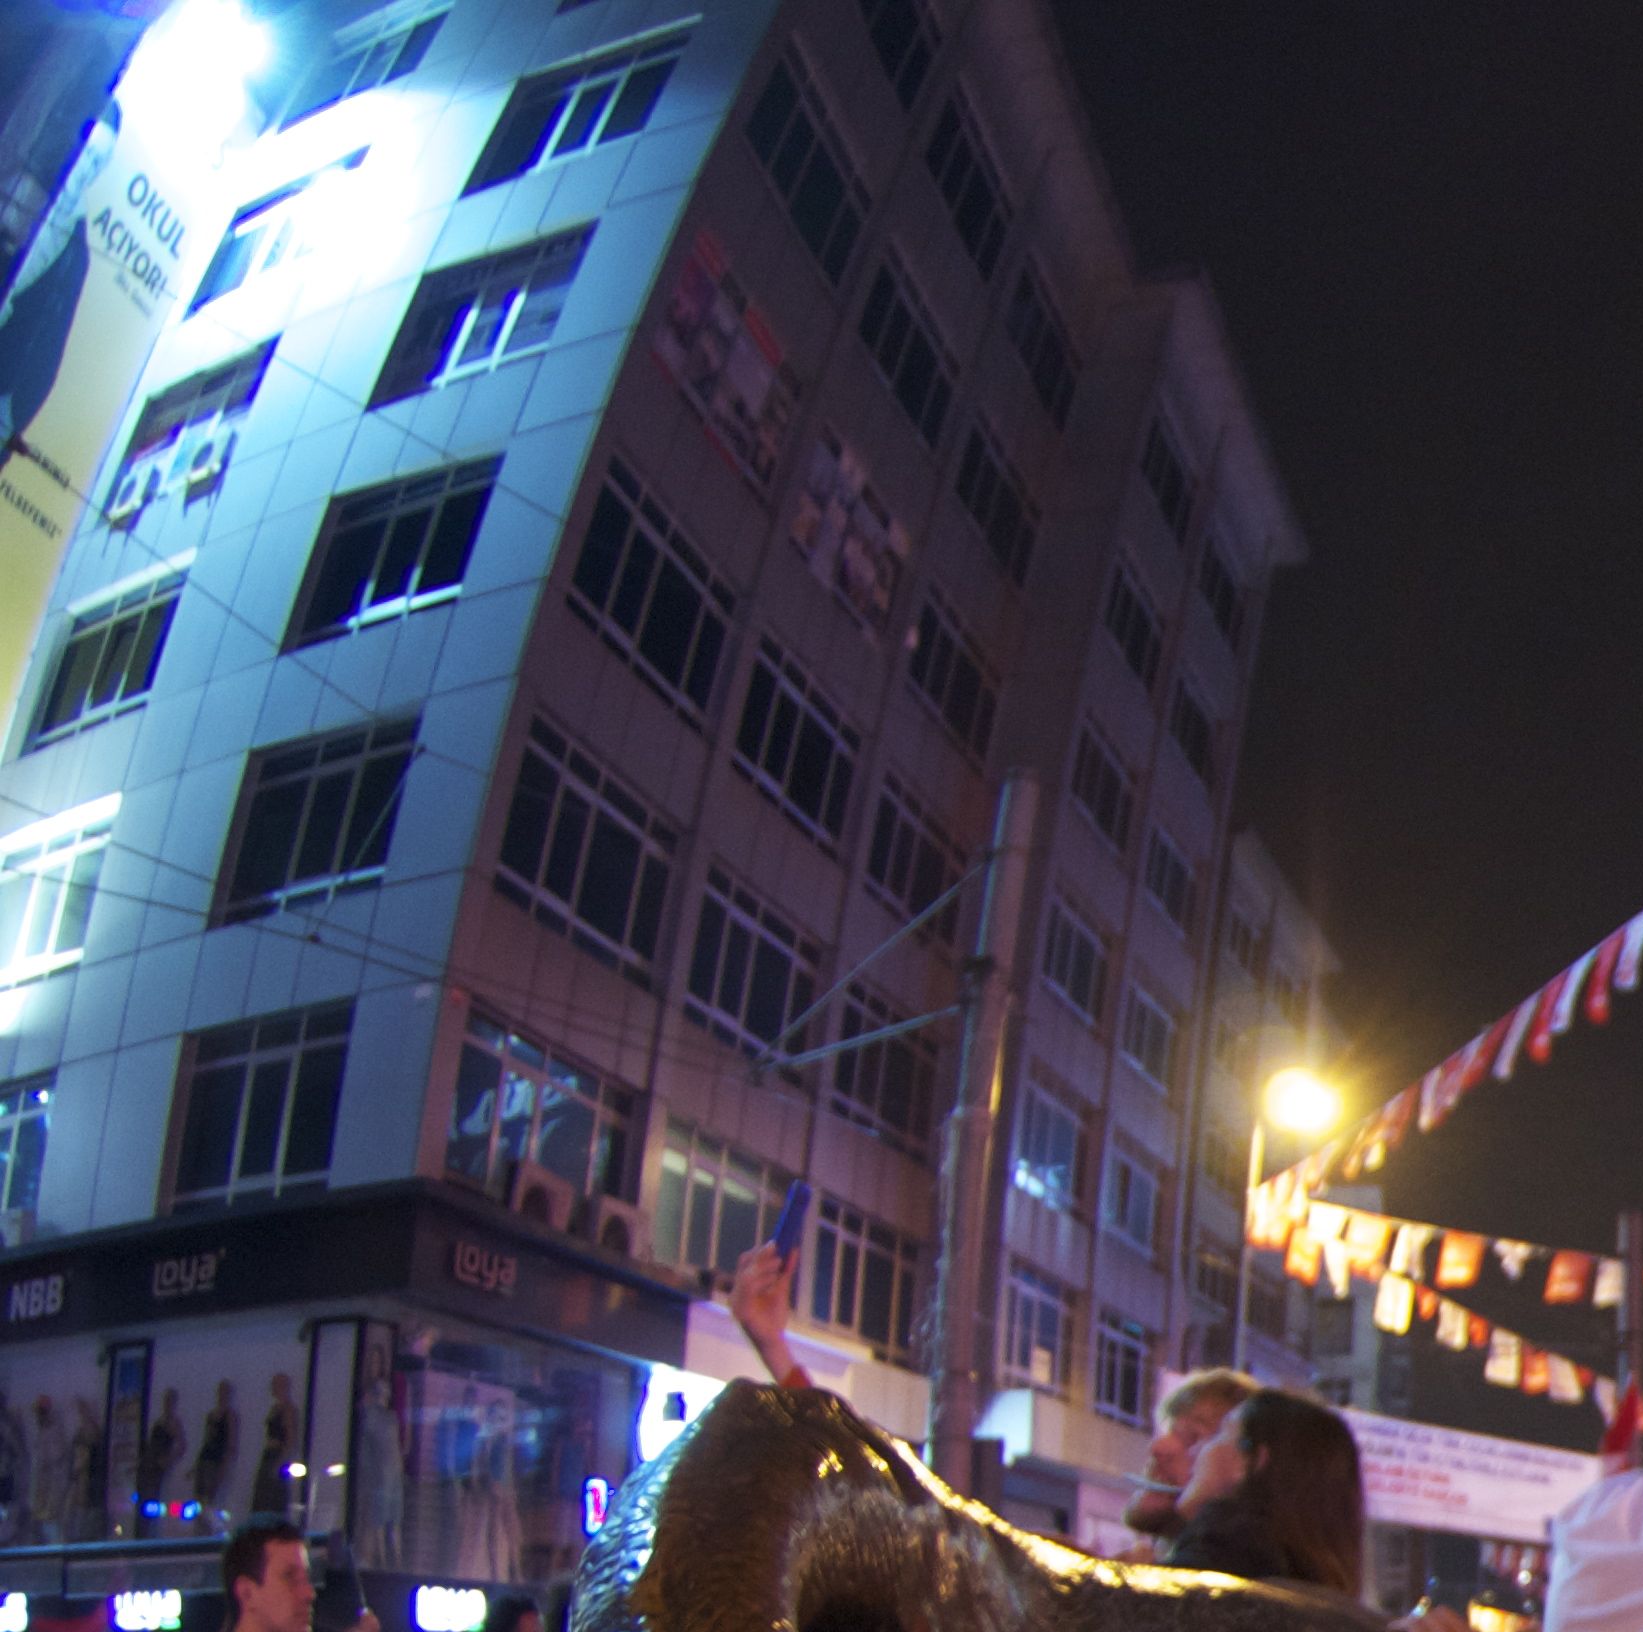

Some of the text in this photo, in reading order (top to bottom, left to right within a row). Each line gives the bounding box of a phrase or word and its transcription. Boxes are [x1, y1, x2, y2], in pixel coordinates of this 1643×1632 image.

[93, 206, 169, 300] AÇIYOR!
[127, 171, 186, 260] OKUL
[9, 1274, 64, 1322] NBB
